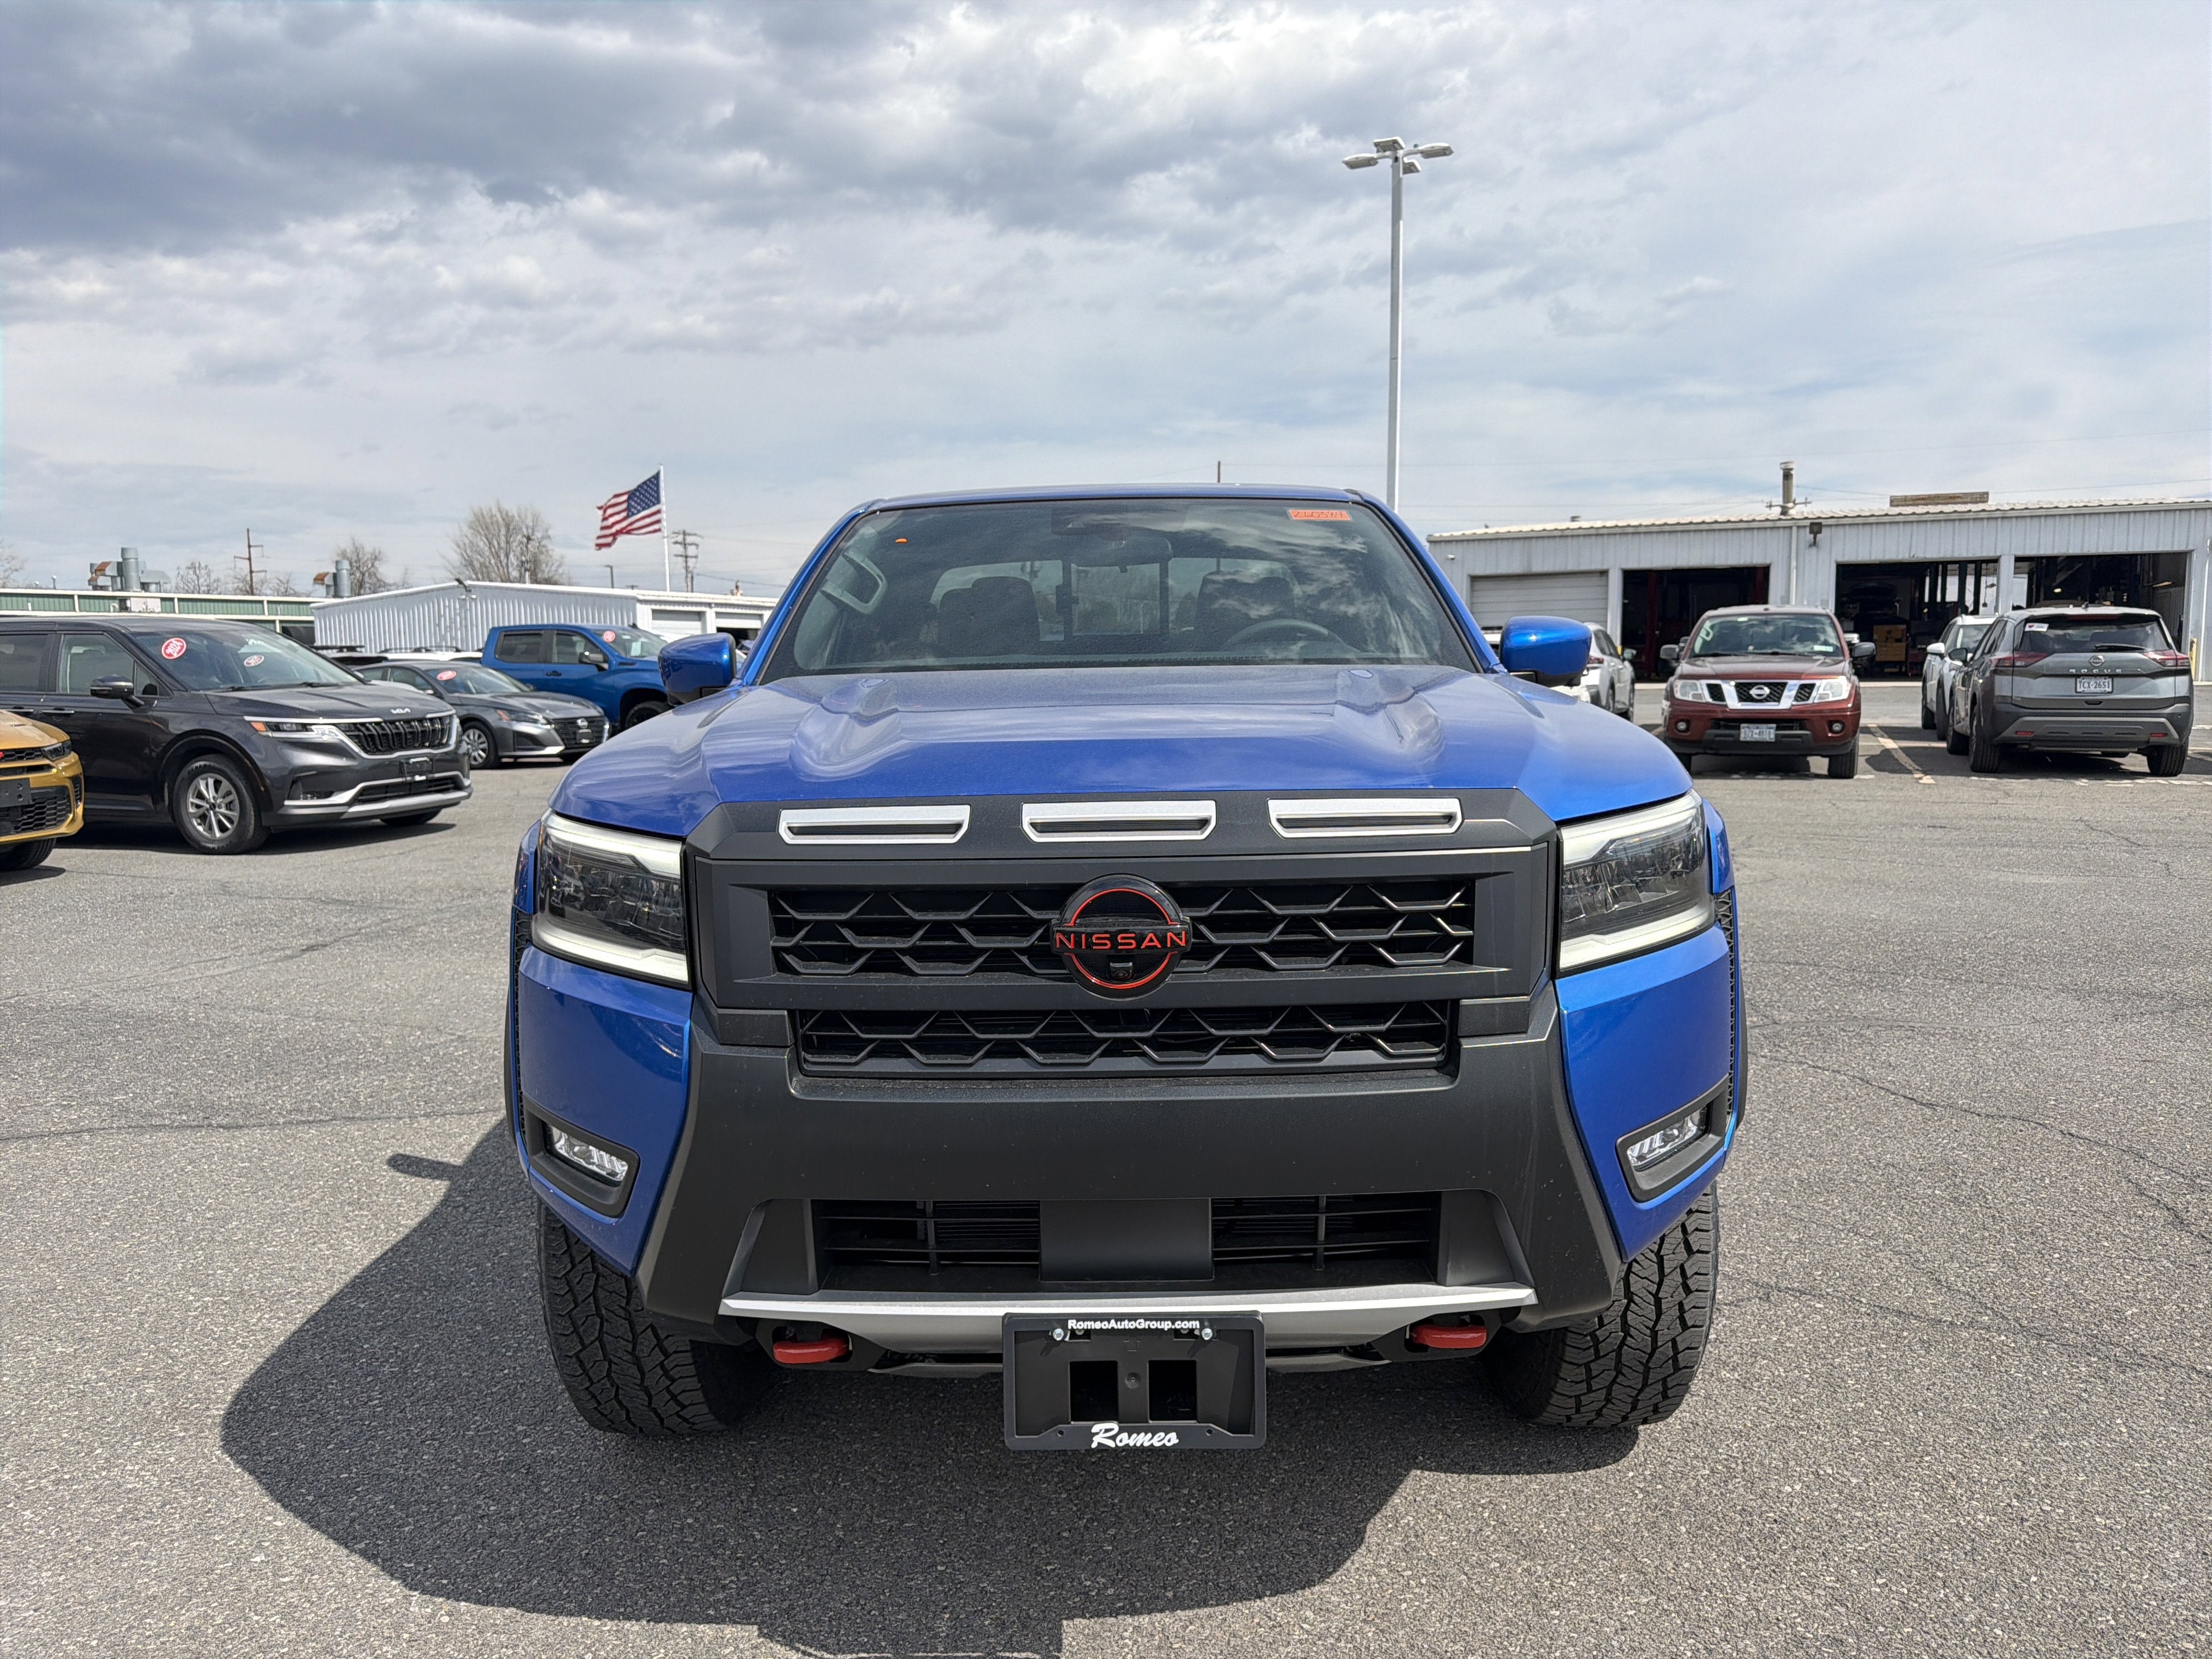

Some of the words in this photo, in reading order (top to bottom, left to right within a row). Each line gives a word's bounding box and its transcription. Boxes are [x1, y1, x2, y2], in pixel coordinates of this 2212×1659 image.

[1056, 930, 1186, 950] NISSAN
[1068, 1319, 1200, 1330] RomeoAutoGroup.com
[1091, 1424, 1179, 1448] Romeo
